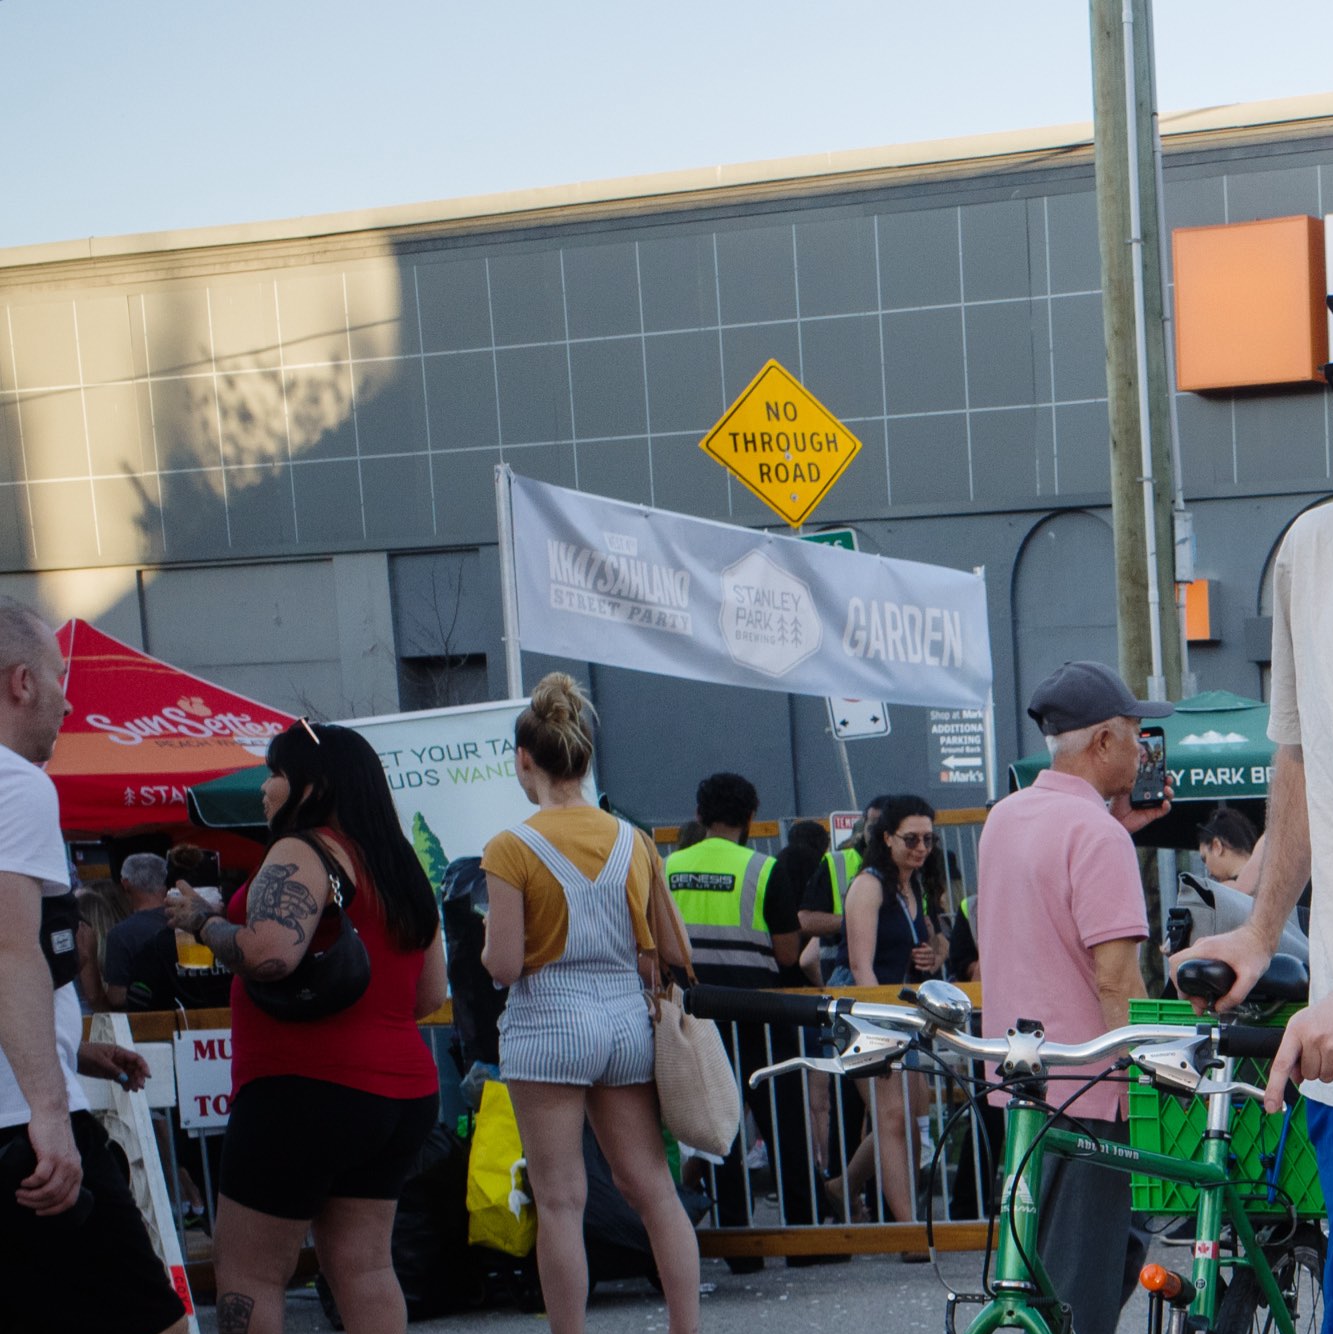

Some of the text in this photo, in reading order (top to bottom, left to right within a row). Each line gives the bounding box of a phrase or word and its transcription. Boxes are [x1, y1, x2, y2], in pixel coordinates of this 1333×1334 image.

[766, 401, 798, 422] NO
[728, 432, 839, 453] THROUGH
[759, 462, 821, 483] ROAD
[553, 588, 690, 630] STREET PARTY
[733, 584, 801, 613] STANLEY
[735, 607, 773, 631] PARK
[735, 630, 776, 645] BREWING
[843, 597, 962, 668] GARDEN
[940, 735, 981, 745] PARKING
[411, 742, 481, 764] YOUR
[388, 769, 440, 790] UDS
[1190, 765, 1245, 786] PARK
[671, 873, 733, 885] GENESIS
[193, 1038, 232, 1061] MU
[194, 1093, 232, 1117] TO
